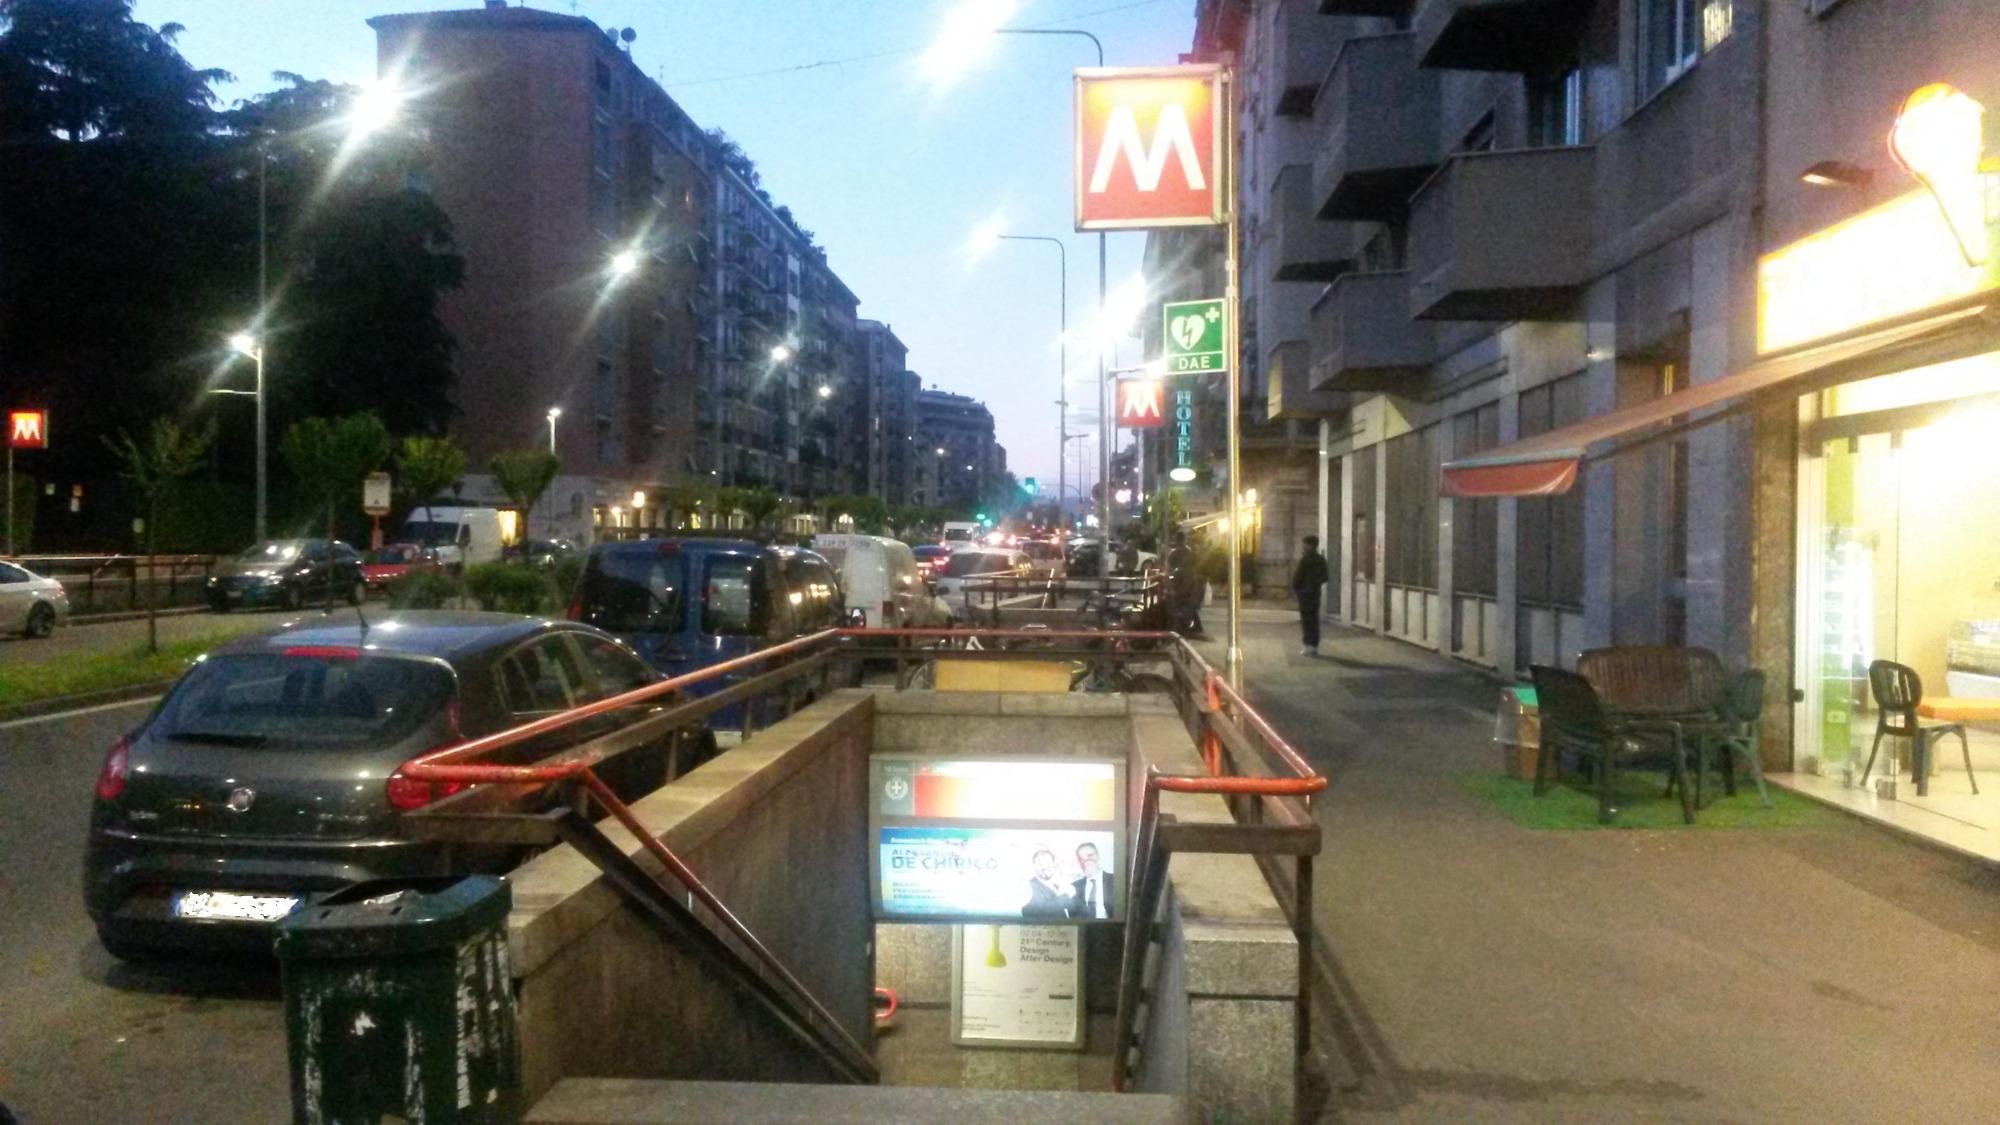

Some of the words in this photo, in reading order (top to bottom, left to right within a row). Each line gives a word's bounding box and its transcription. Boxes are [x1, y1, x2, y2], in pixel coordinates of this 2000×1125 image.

[1089, 105, 1206, 193] M
[1178, 355, 1211, 370] DAE
[1122, 386, 1160, 418] M
[13, 418, 41, 440] M
[1176, 391, 1192, 466] HOTEL
[891, 856, 916, 869] DE
